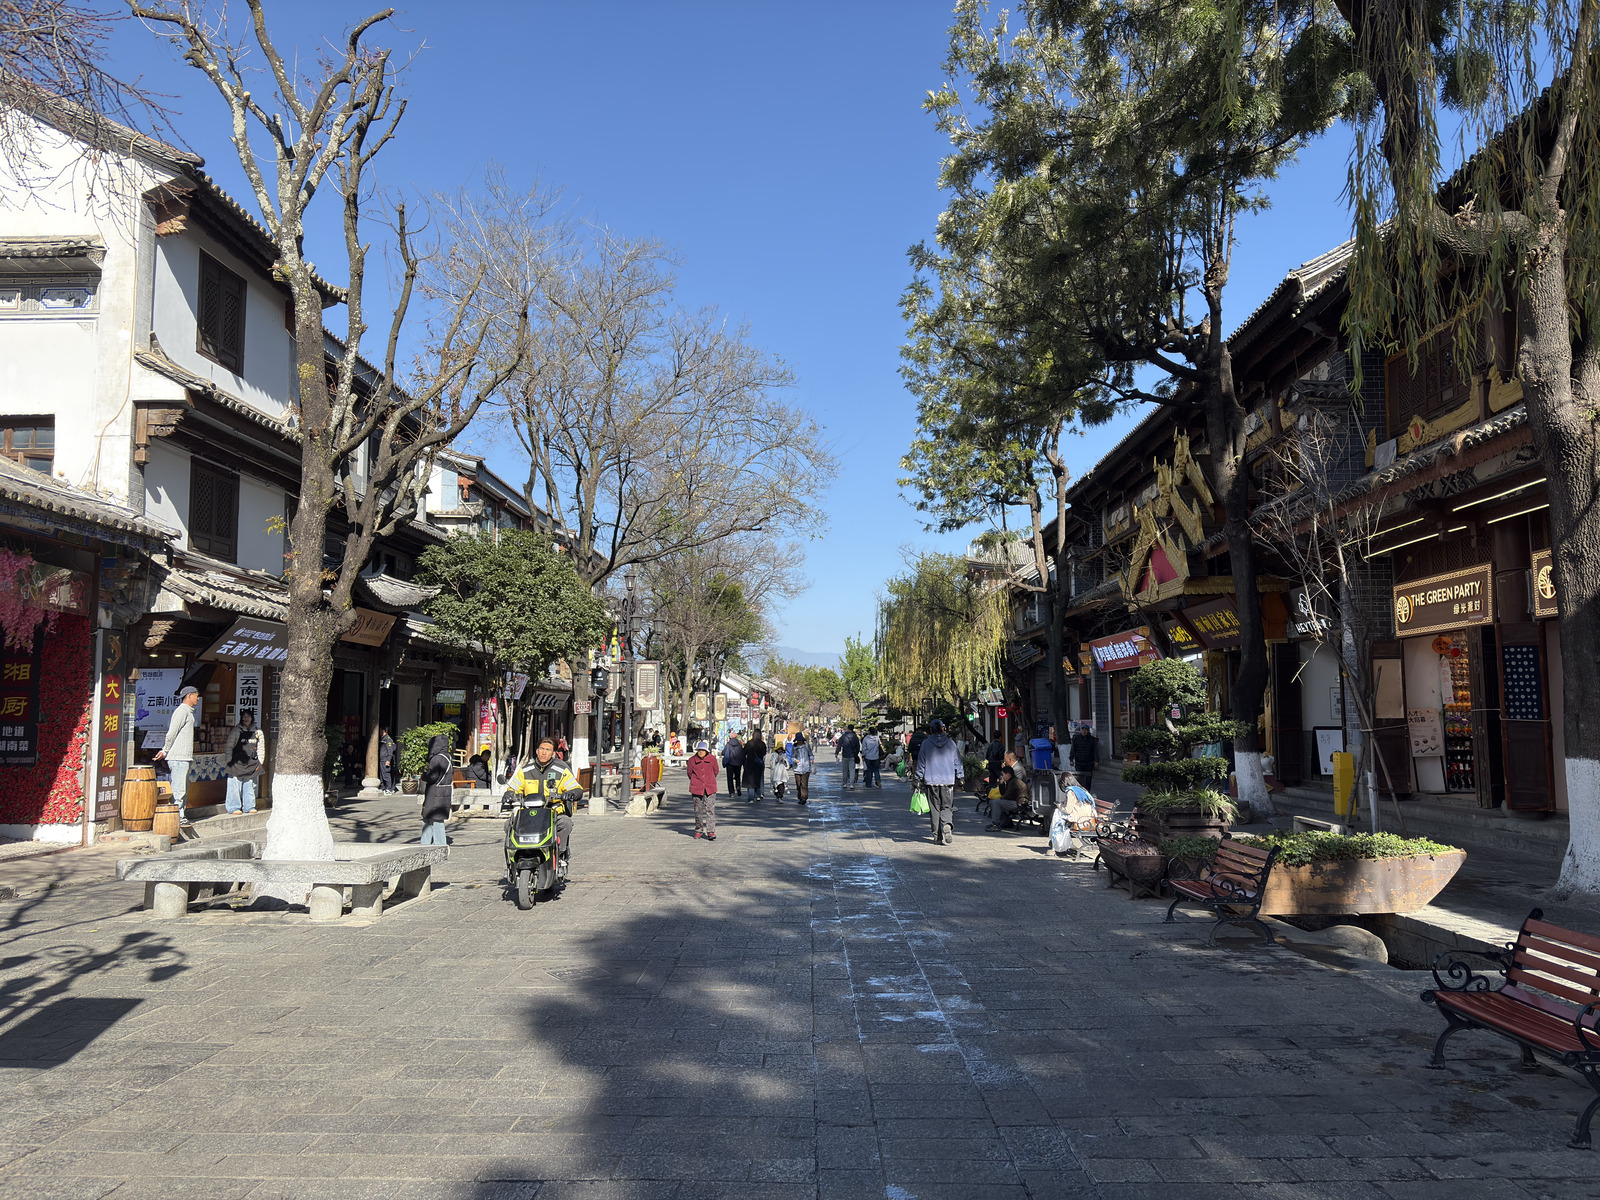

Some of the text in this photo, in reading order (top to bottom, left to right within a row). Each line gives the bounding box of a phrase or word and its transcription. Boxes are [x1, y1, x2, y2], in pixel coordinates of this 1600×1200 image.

[1411, 580, 1481, 607] THE GREEN PARTY
[1453, 600, 1481, 615] 绿光派对
[2, 726, 24, 737] 地道
[101, 680, 120, 767] 大湘厨
